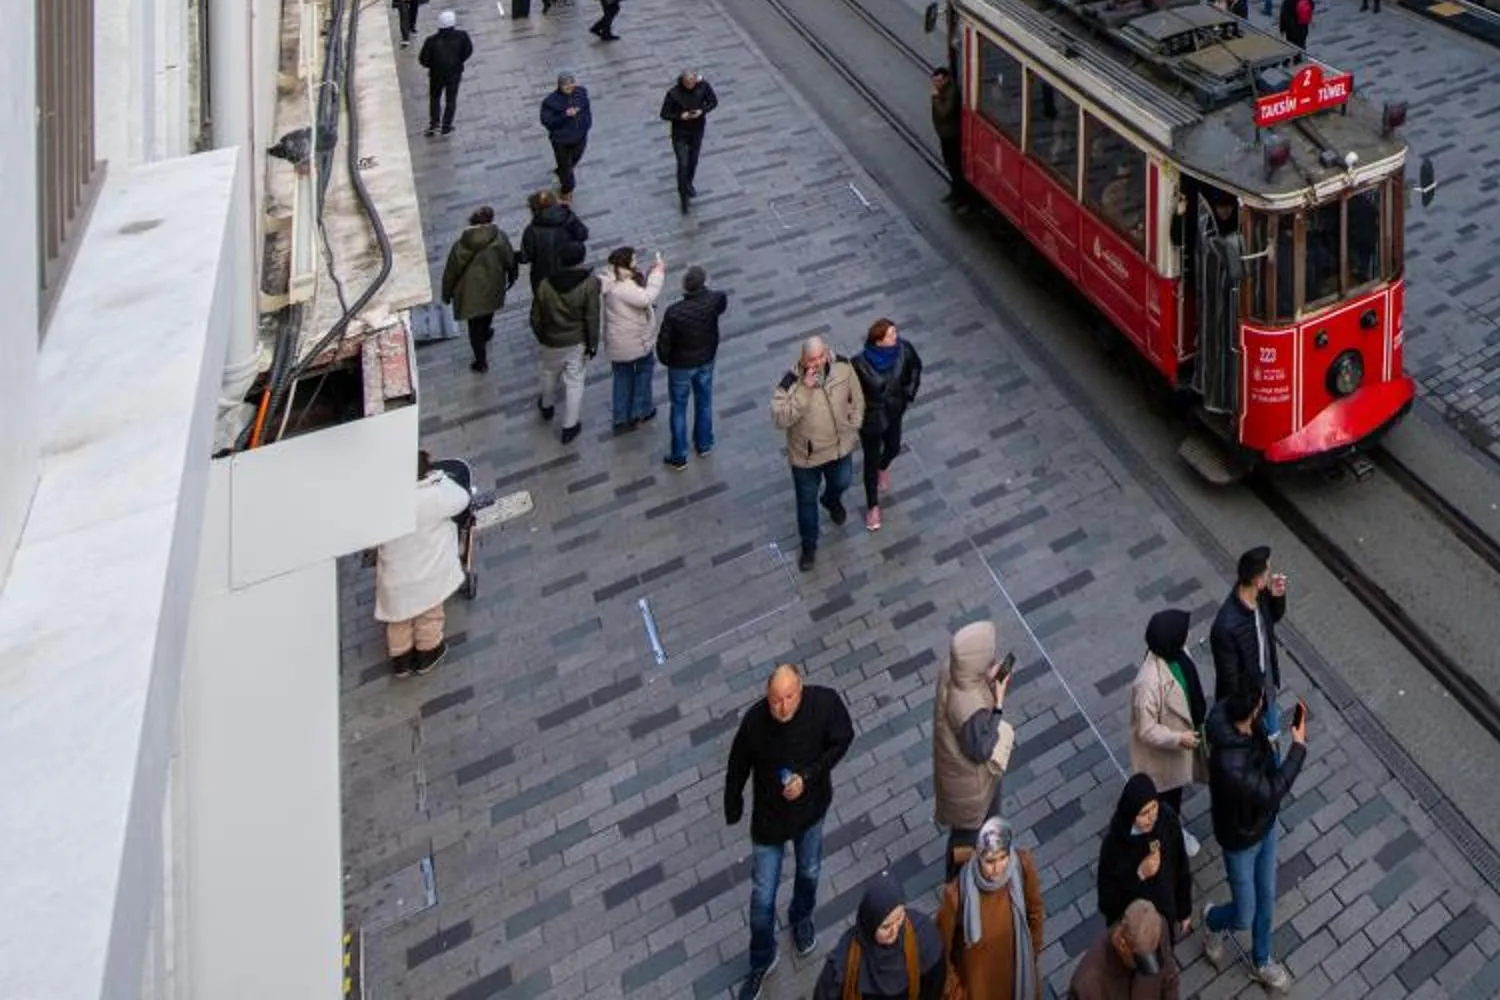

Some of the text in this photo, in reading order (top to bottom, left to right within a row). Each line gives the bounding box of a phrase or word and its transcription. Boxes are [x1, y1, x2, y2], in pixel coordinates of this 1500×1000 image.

[1303, 69, 1313, 87] 2
[1260, 95, 1298, 120] TAKSİM
[1318, 83, 1347, 102] TÜNEL
